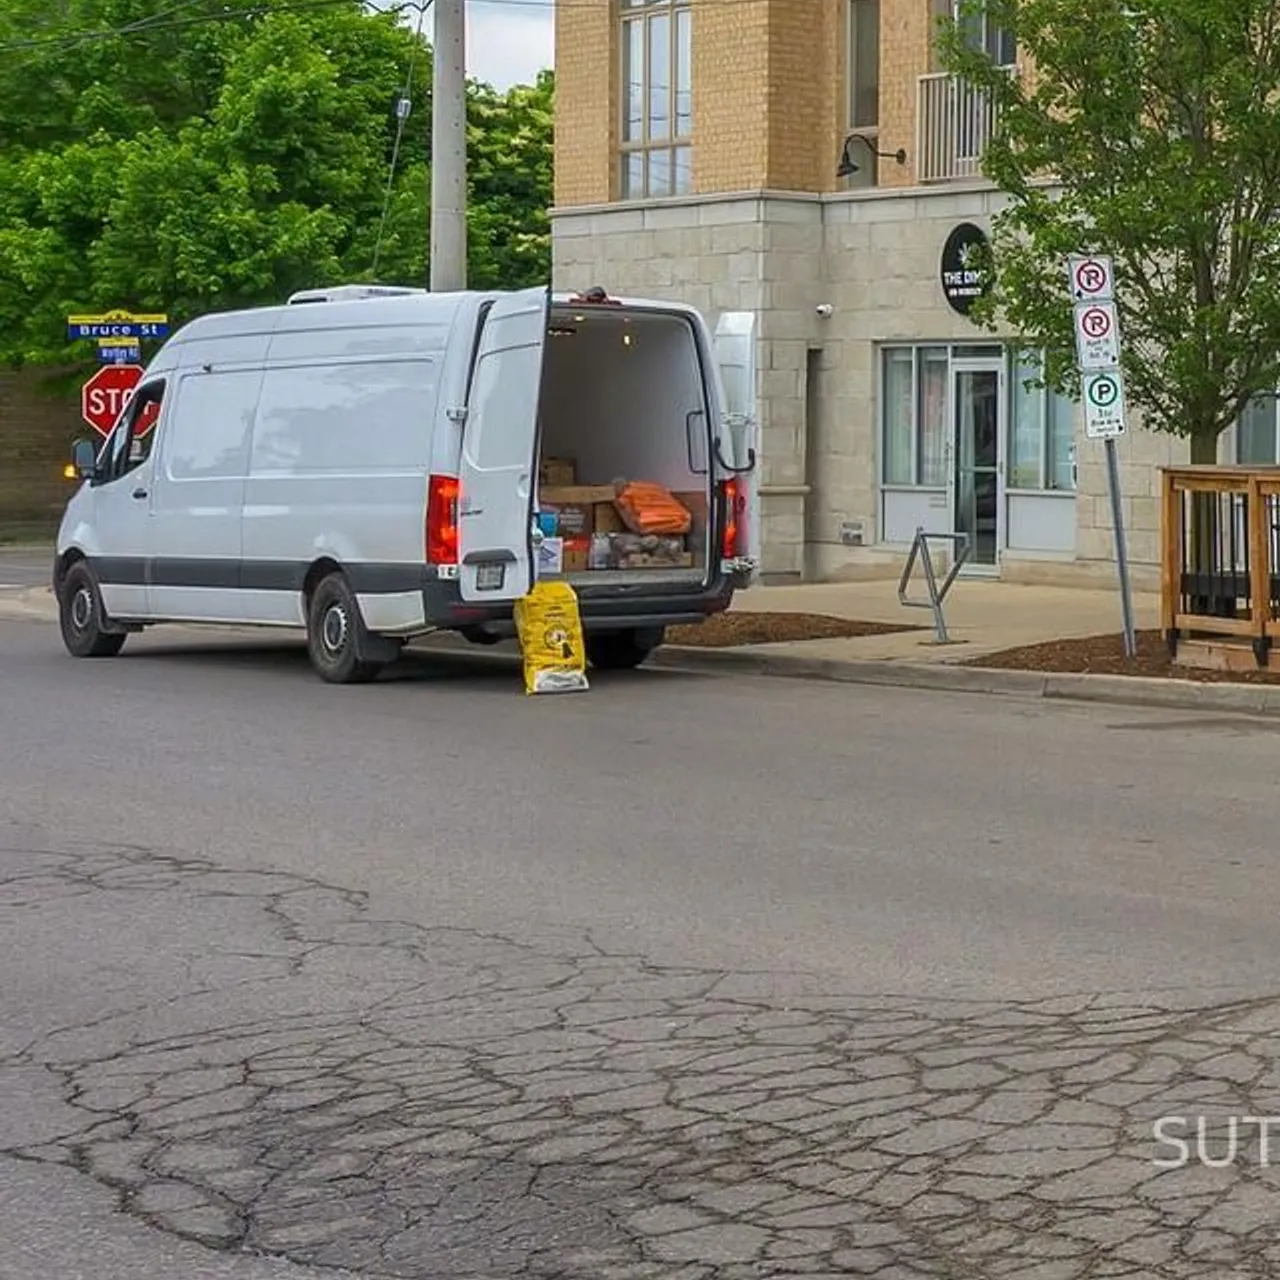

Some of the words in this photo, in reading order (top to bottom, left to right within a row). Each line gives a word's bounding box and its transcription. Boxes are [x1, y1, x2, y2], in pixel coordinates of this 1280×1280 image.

[944, 271, 963, 285] THE
[80, 324, 132, 336] Bruce
[141, 323, 159, 335] St
